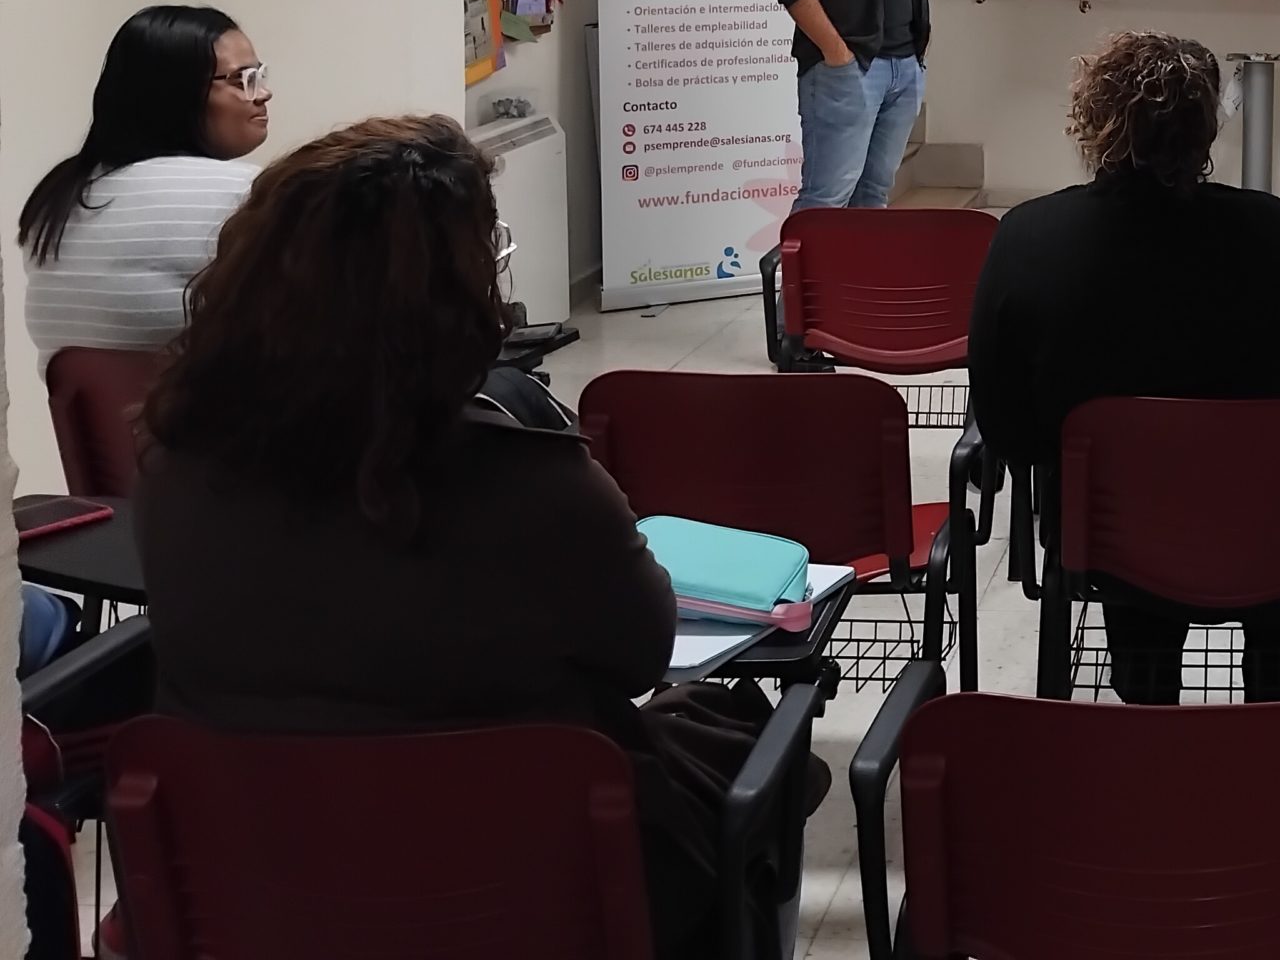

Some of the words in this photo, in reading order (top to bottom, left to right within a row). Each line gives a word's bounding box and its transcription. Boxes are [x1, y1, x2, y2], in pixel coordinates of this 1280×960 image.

[634, 4, 697, 17] Orientación
[699, 6, 706, 14] e
[634, 23, 676, 34] Talleres
[678, 22, 692, 33] de
[695, 20, 768, 33] empleabilidad
[634, 41, 676, 52] Talleres
[679, 40, 693, 51] de
[695, 38, 754, 52] adquisición
[756, 36, 769, 47] de
[635, 58, 698, 70] Certificados
[700, 56, 714, 67] de
[635, 77, 664, 88] Bolsa
[666, 76, 680, 87] de
[683, 74, 730, 88] prácticas
[732, 76, 738, 85] y
[741, 72, 779, 84] empleo
[623, 100, 678, 113] Contacto
[643, 124, 663, 135] 674
[665, 123, 685, 133] 445
[687, 121, 707, 132] 228
[643, 133, 792, 153] psemprende@salesianas.org
[630, 265, 711, 285] Salesianas
